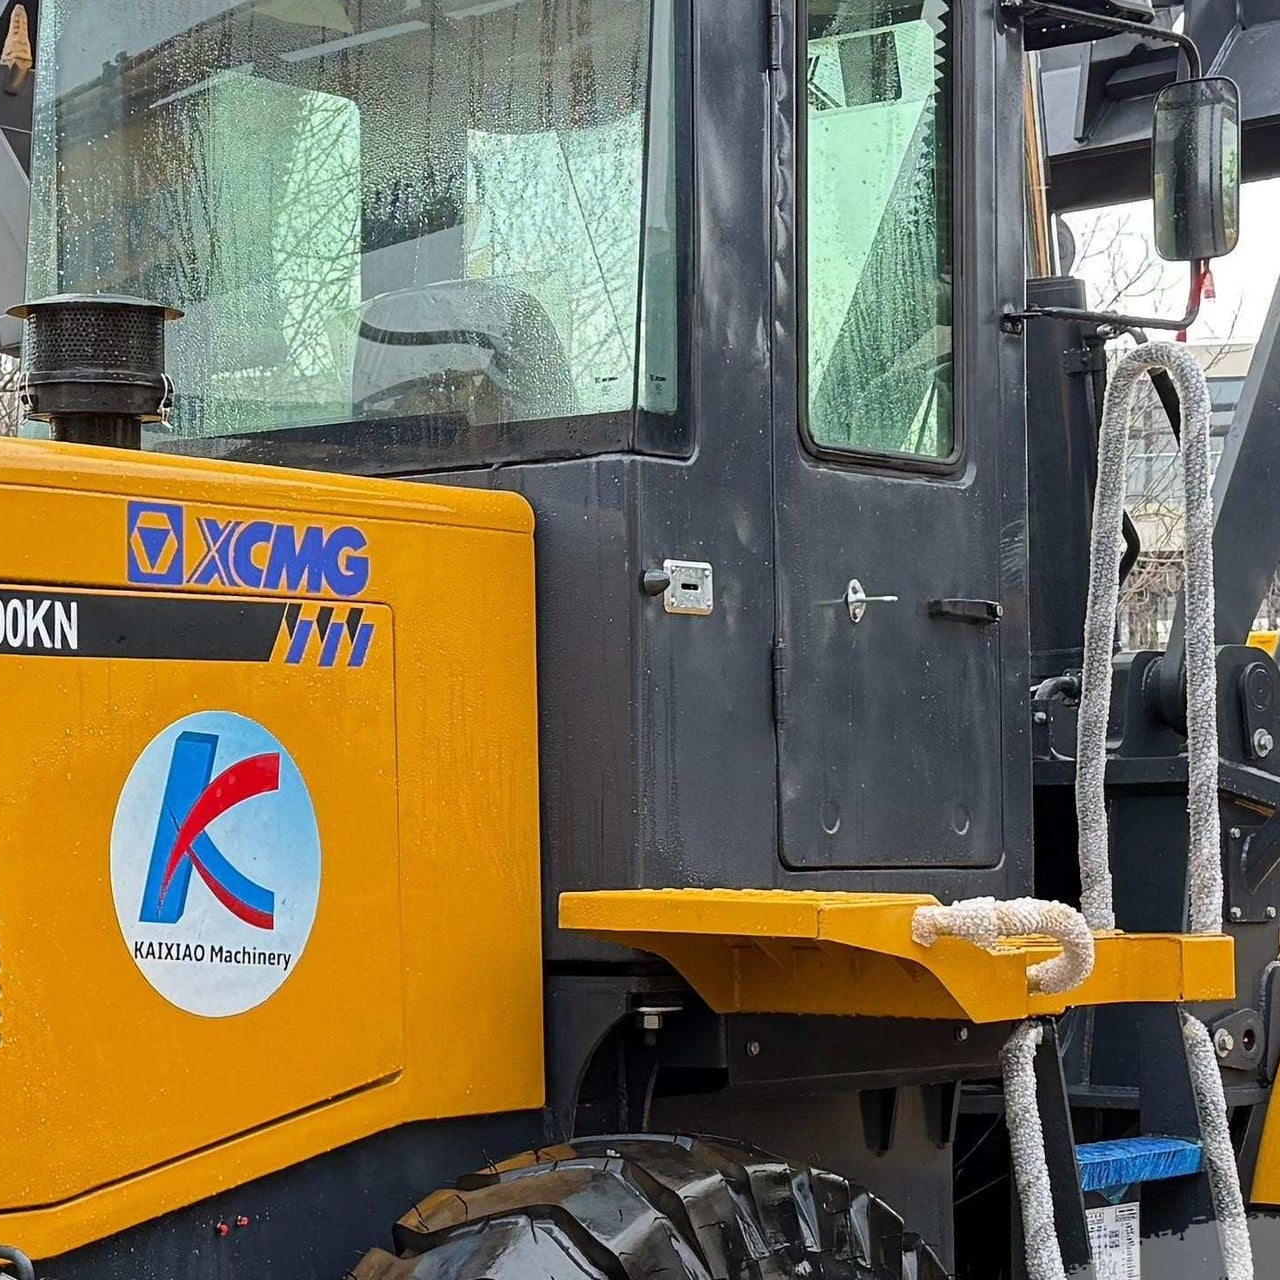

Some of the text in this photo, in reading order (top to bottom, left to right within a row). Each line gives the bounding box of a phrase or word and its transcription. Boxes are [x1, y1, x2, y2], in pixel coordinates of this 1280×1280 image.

[184, 516, 372, 598] XCMG
[133, 941, 292, 971] KAIXIAO Machinery
